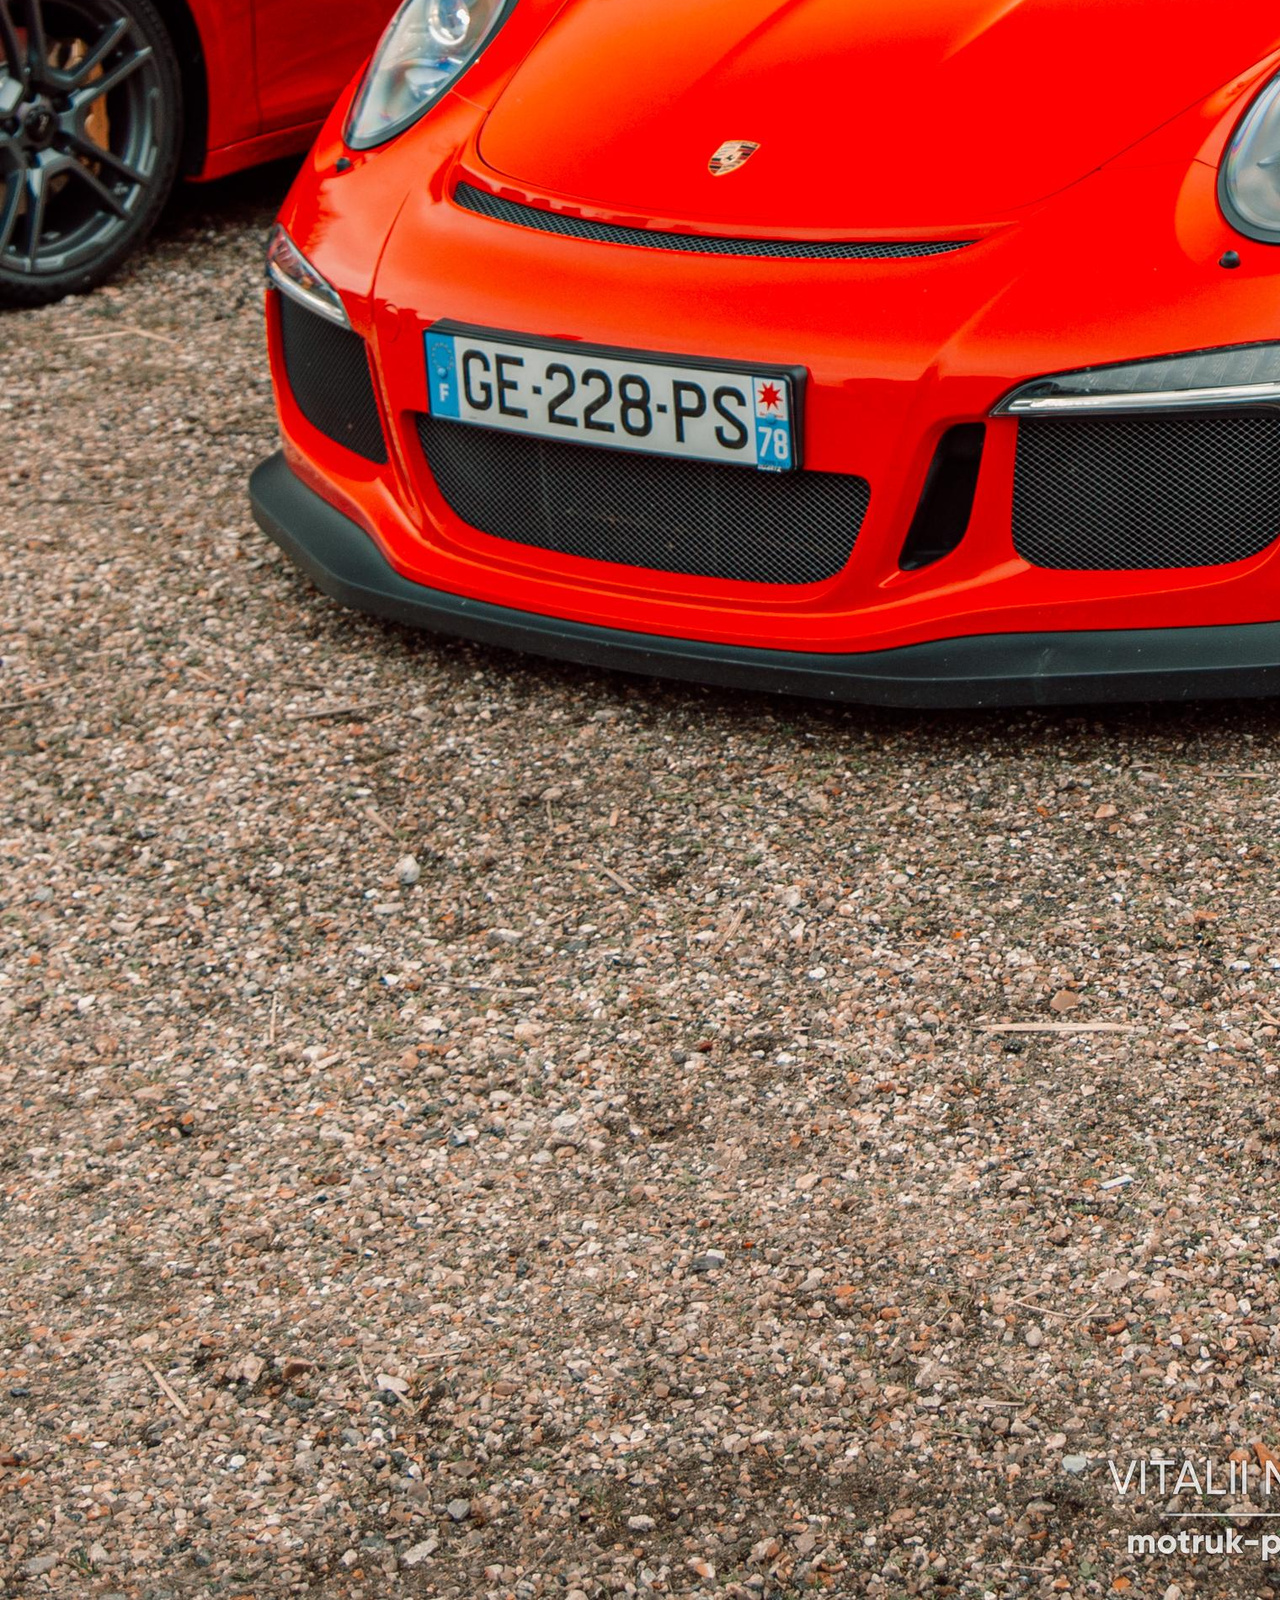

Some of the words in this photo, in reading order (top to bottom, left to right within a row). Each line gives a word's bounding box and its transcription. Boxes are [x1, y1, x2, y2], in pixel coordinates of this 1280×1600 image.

[439, 382, 449, 401] F
[462, 348, 749, 450] GE-228-PS
[758, 426, 788, 460] 78
